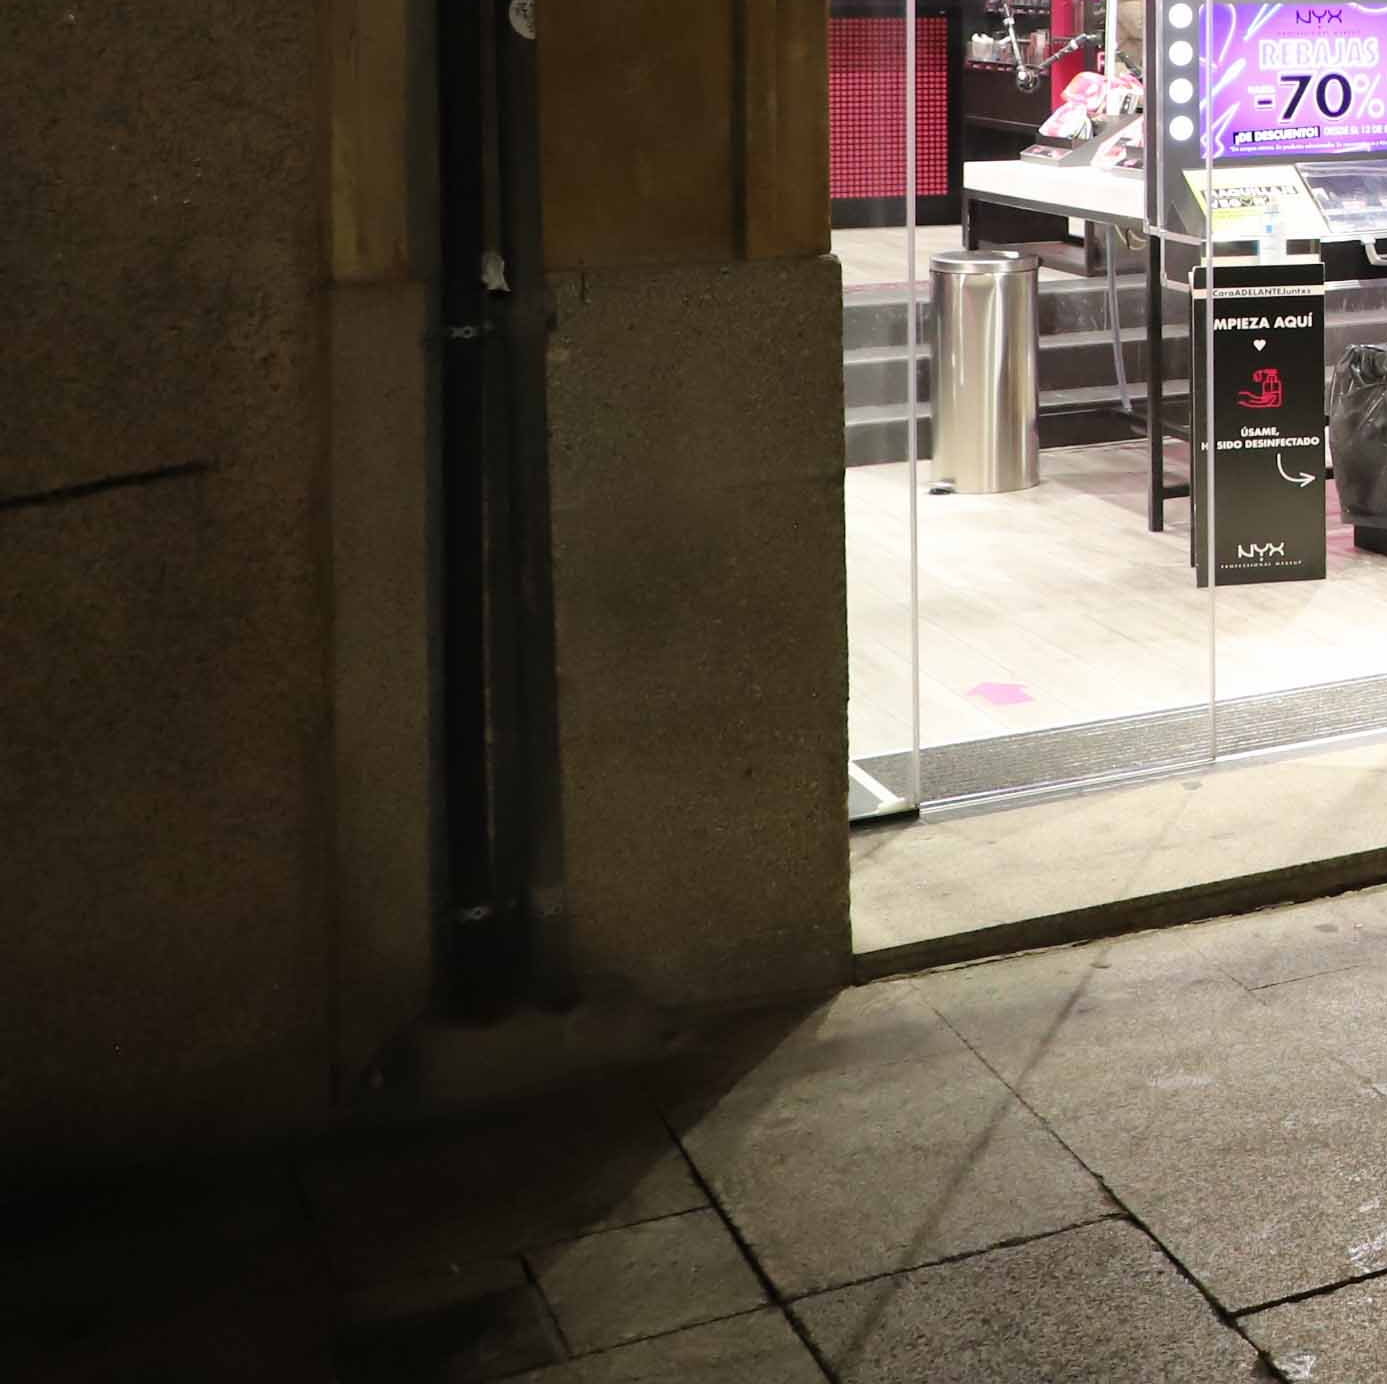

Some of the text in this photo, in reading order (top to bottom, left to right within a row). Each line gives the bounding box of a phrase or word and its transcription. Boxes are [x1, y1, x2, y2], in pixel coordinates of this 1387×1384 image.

[1295, 9, 1343, 24] NYX
[1259, 38, 1379, 69] REBAJAS
[1255, 72, 1385, 122] -70%
[1255, 126, 1319, 142] DESCUENTO!
[1213, 312, 1314, 331] MPIEZA AQUÍ
[1240, 426, 1280, 438] ÚSAME,
[1216, 440, 1243, 450] SIDO
[1244, 437, 1320, 449] DESINFECTADO
[1237, 542, 1285, 558] NYX
